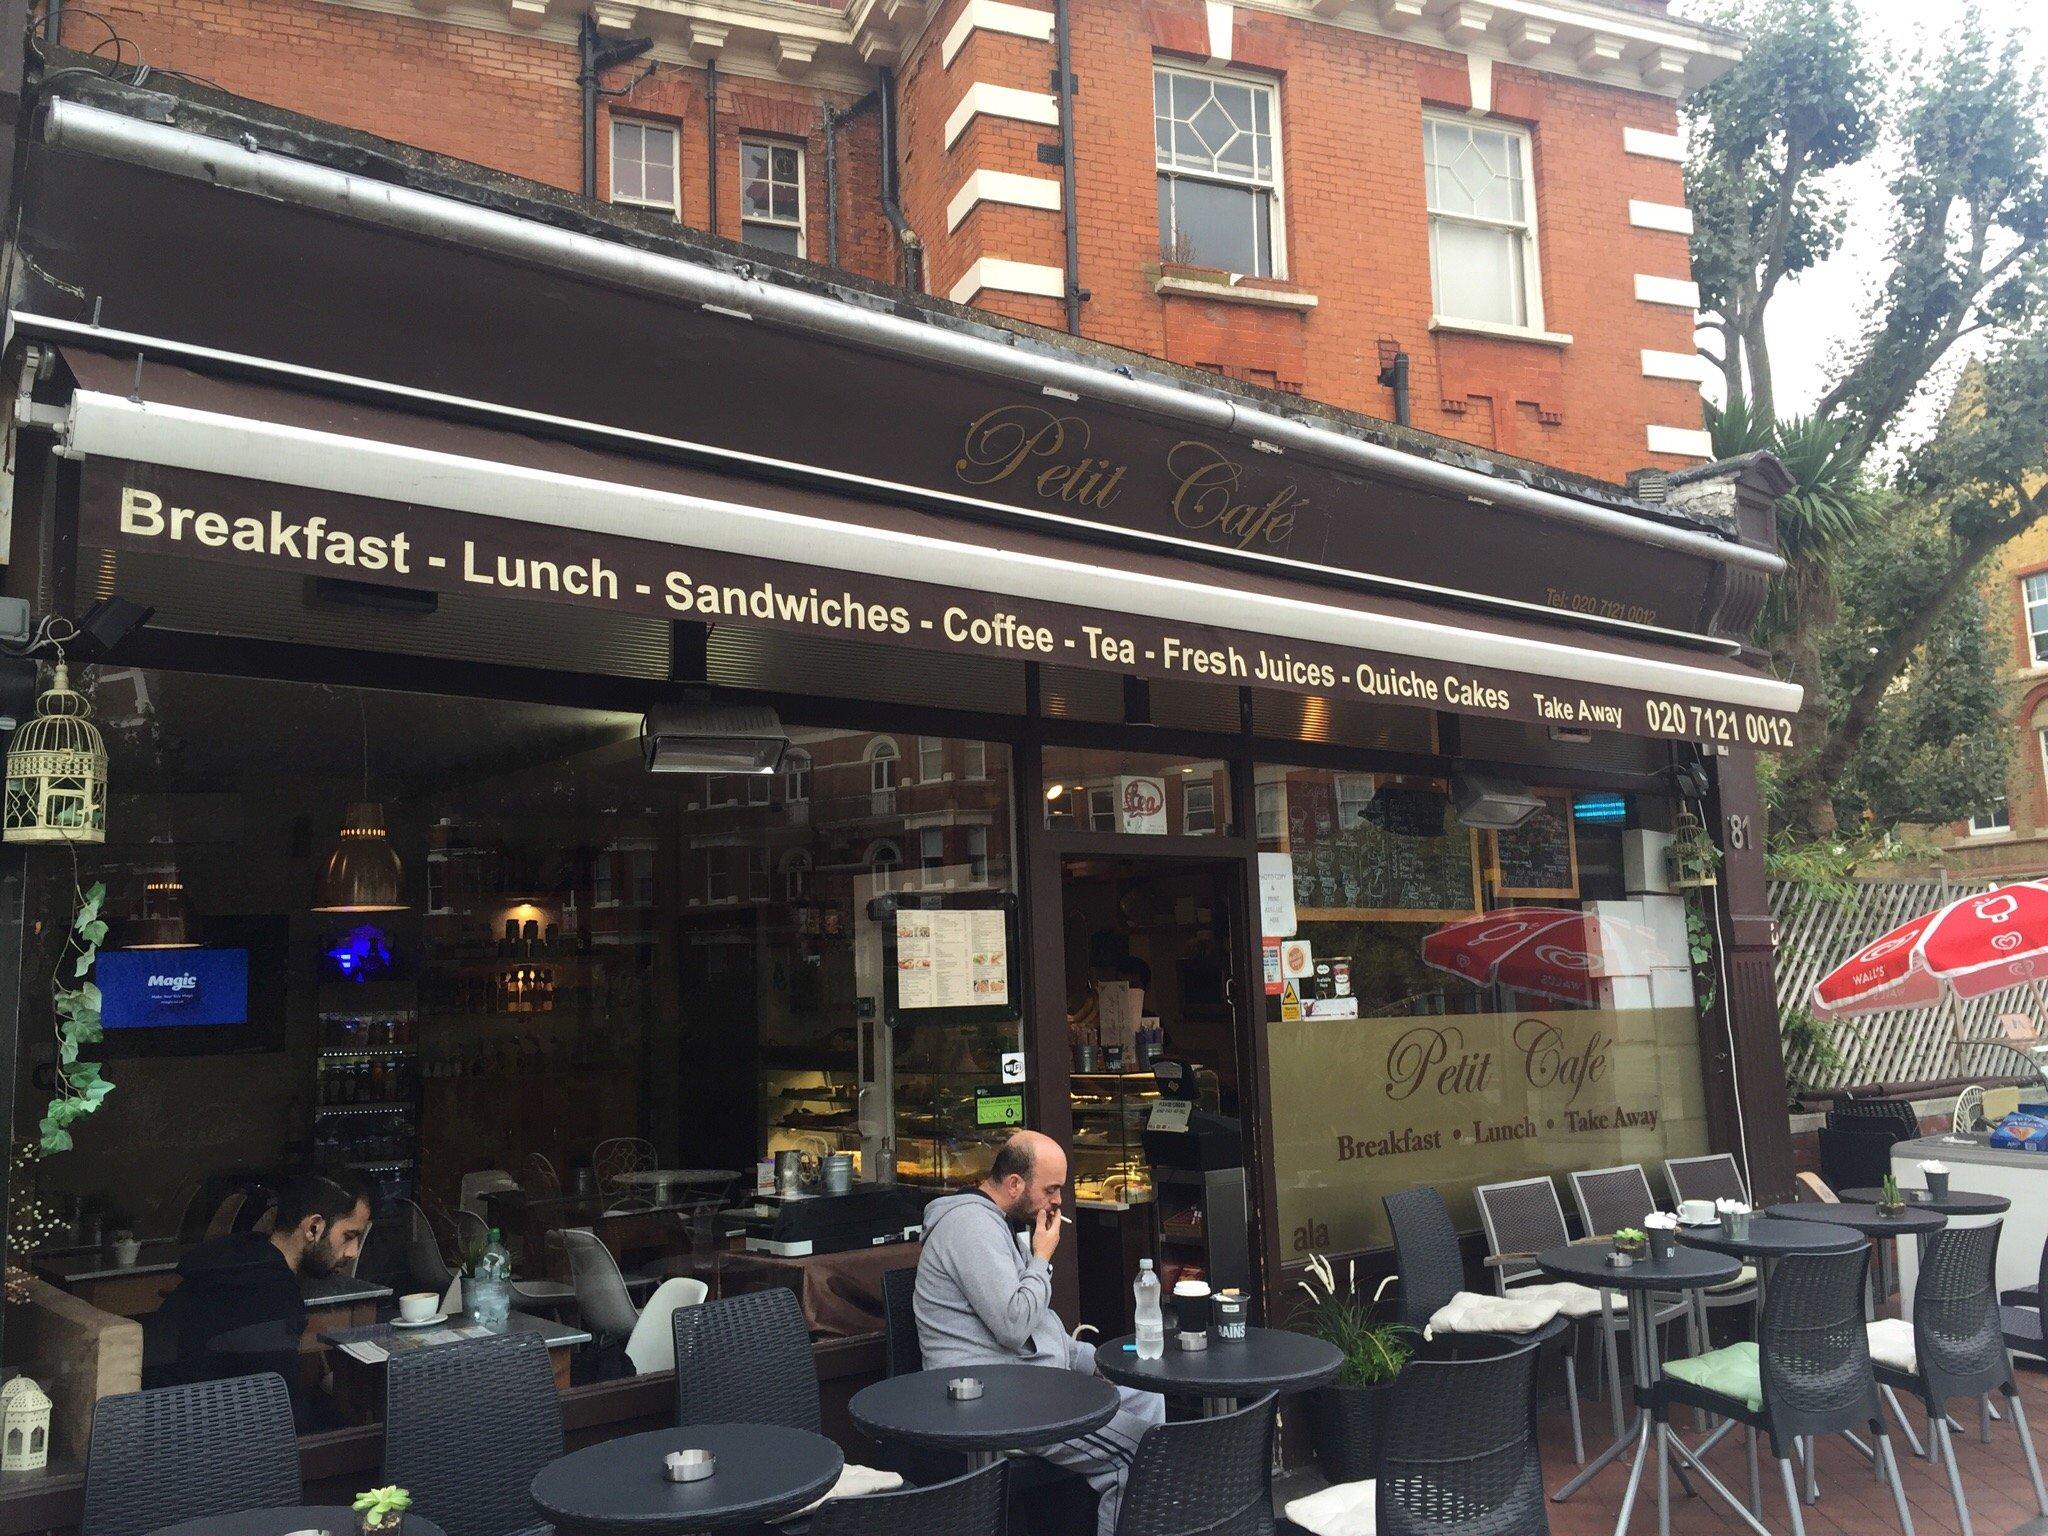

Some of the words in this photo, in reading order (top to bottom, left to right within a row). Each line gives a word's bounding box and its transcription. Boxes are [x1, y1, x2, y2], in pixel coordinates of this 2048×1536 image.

[955, 404, 1128, 509] Petit
[1166, 441, 1311, 550] Café
[120, 486, 410, 574] Breakfast
[463, 540, 618, 600] Lunch
[665, 571, 911, 634] Sandwiches
[943, 606, 1054, 653] Coffee
[1081, 625, 1136, 665] Tea
[1163, 637, 1248, 677] Fresh
[1254, 650, 1336, 688] Juices
[1356, 663, 1439, 701] Quiche
[1443, 675, 1510, 711] Cakes
[1572, 593, 1597, 614] 020
[1600, 599, 1626, 620] 7121
[1627, 605, 1657, 626] 0012
[1532, 693, 1574, 721] Take
[1578, 699, 1623, 729] Away
[1645, 699, 1686, 734] 020
[1689, 705, 1740, 741] 7121
[1745, 713, 1794, 748] 0012
[1730, 814, 1753, 850] 81
[148, 972, 197, 991] Magic
[1385, 1026, 1492, 1101] Petit
[1513, 1018, 1612, 1107] Café
[1337, 1127, 1442, 1162] Breakfast
[1472, 1115, 1538, 1144] Lunch
[1564, 1109, 1609, 1134] Take
[1614, 1106, 1659, 1131] Away
[1293, 1217, 1330, 1252] ala
